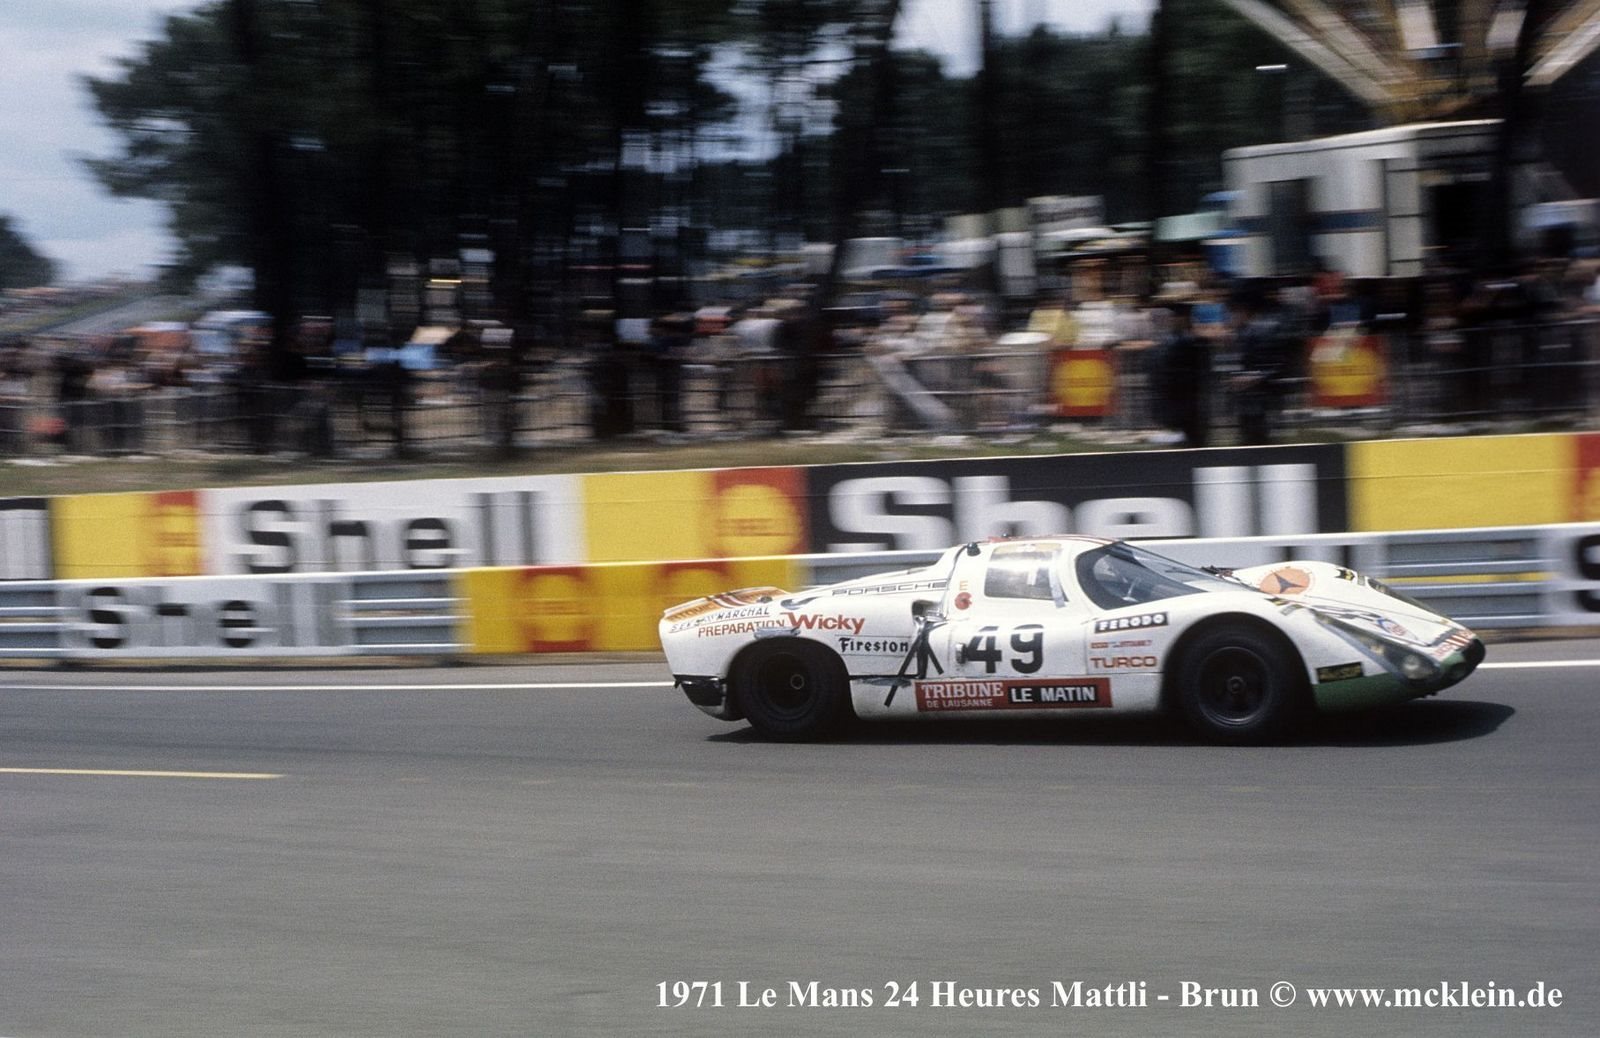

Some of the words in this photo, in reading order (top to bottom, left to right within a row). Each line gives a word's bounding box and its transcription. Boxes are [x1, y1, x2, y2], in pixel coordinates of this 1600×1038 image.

[828, 464, 1318, 550] Shell
[246, 490, 538, 576] Shell
[831, 581, 948, 597] PORSCHE
[716, 606, 770, 620] MARCHAL
[698, 619, 786, 638] PREPARATION
[779, 611, 865, 635] Wicky
[1098, 613, 1165, 631] FERODO
[838, 636, 911, 653] Fireston
[966, 623, 1045, 675] 49
[1090, 655, 1158, 669] TURCO
[920, 682, 1005, 699] TRIBUNE
[1010, 687, 1033, 703] LE
[1040, 686, 1096, 702] MATIN
[926, 701, 940, 709] DE
[942, 698, 993, 708] LAUSANNE
